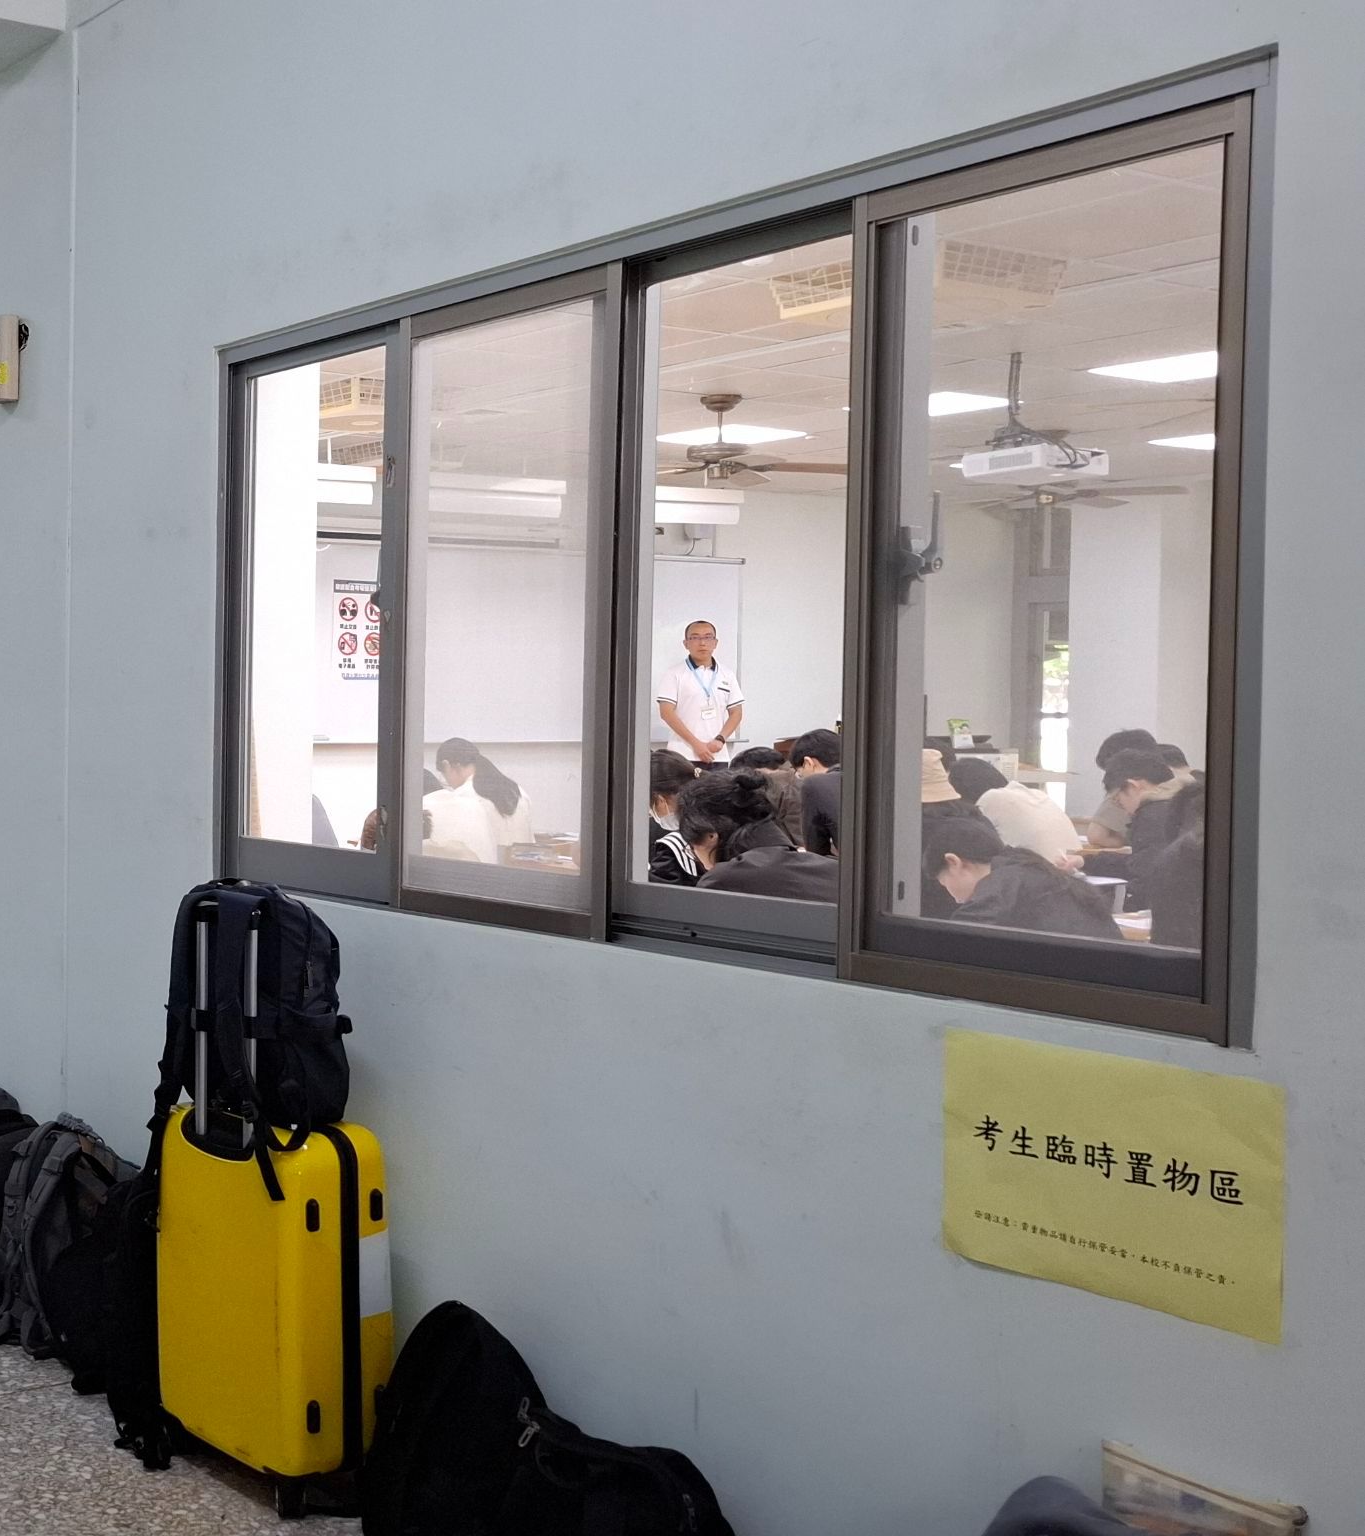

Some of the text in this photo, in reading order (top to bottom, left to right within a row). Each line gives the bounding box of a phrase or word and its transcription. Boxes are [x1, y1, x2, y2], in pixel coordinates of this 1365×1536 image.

[972, 1114, 1244, 1206] 考生臨時置物區
